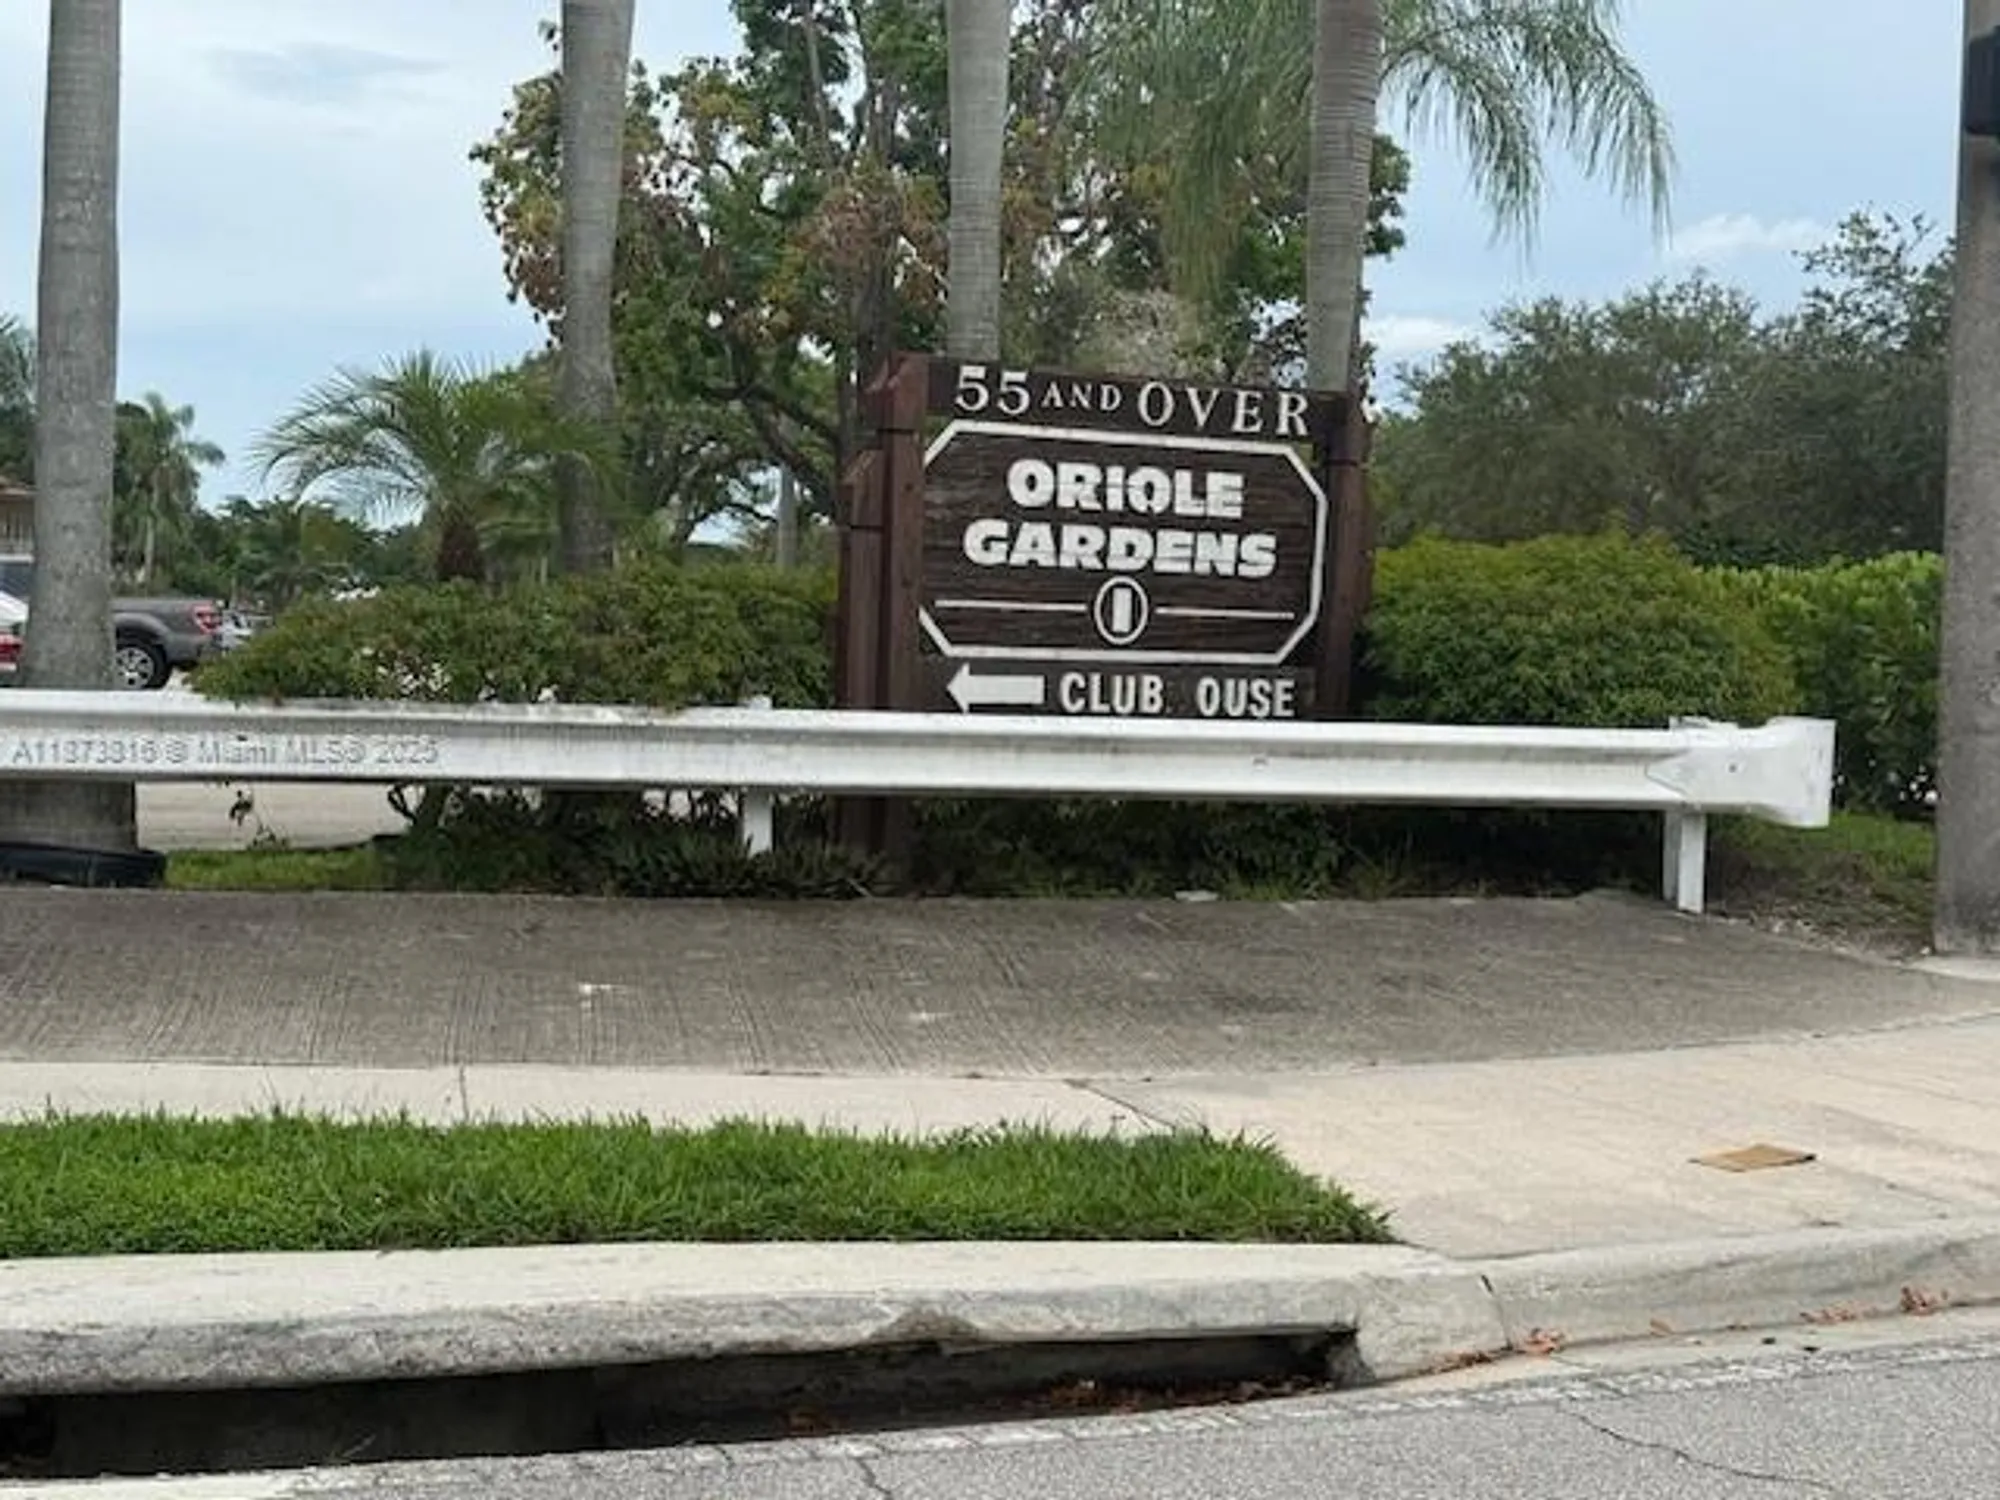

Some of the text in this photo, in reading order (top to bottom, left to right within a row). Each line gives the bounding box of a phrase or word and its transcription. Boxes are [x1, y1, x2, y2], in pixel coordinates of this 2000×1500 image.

[955, 365, 1310, 436] 55 AND OVER
[1006, 459, 1245, 519] ORIOLE
[962, 519, 1277, 578] GARDENS
